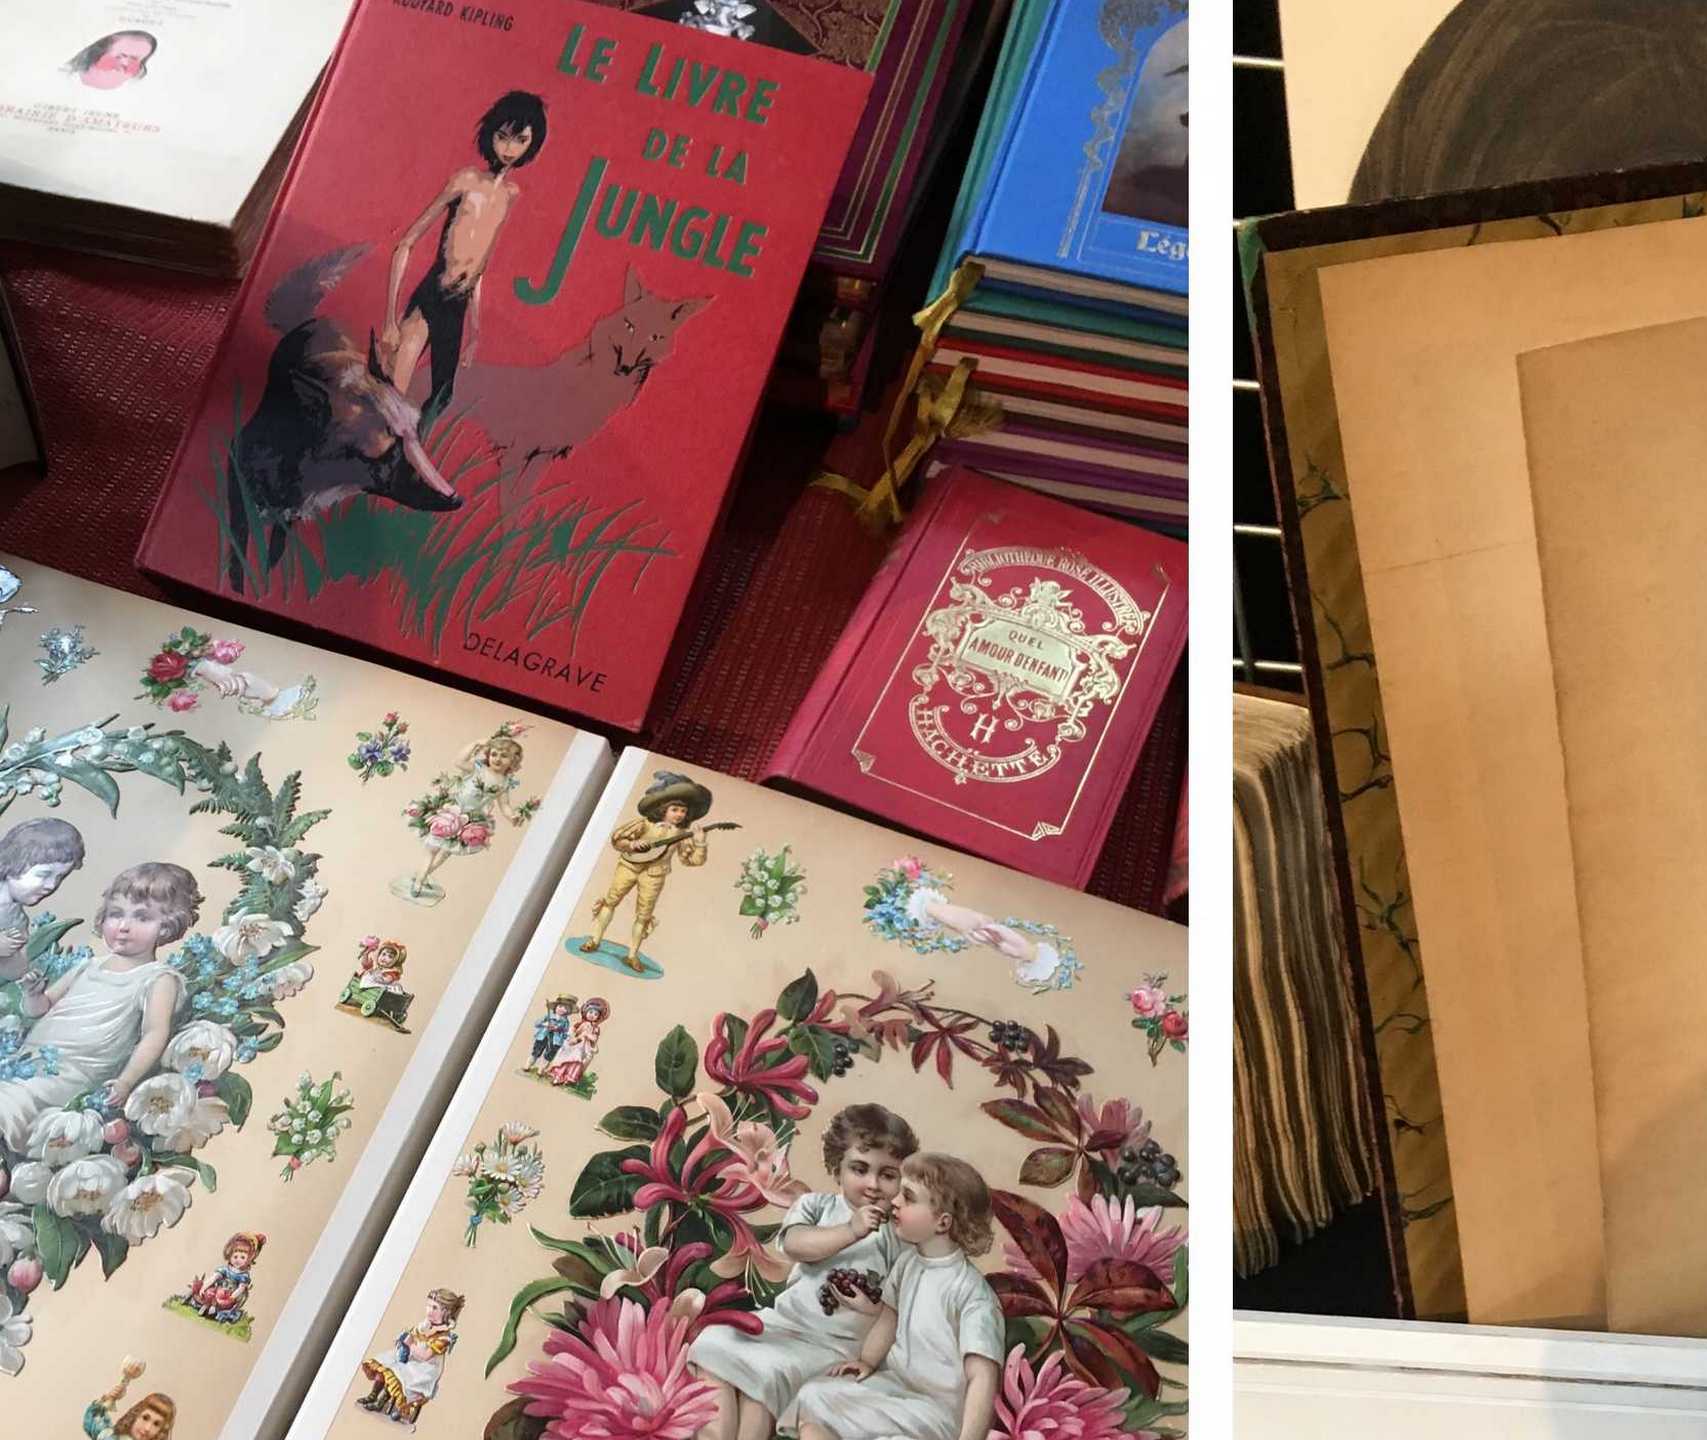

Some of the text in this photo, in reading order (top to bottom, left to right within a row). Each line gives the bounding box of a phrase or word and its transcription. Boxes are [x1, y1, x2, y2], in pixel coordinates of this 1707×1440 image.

[460, 6, 515, 32] KIPLING
[556, 23, 780, 126] LE LIVRE
[642, 128, 749, 185] DE LA
[513, 156, 769, 305] JUNGLE
[464, 633, 608, 692] DELAGRAVE
[968, 637, 1015, 664] AMOUR
[1009, 630, 1044, 650] QUEL
[916, 708, 1051, 777] HACHETTE
[970, 713, 999, 743] H
